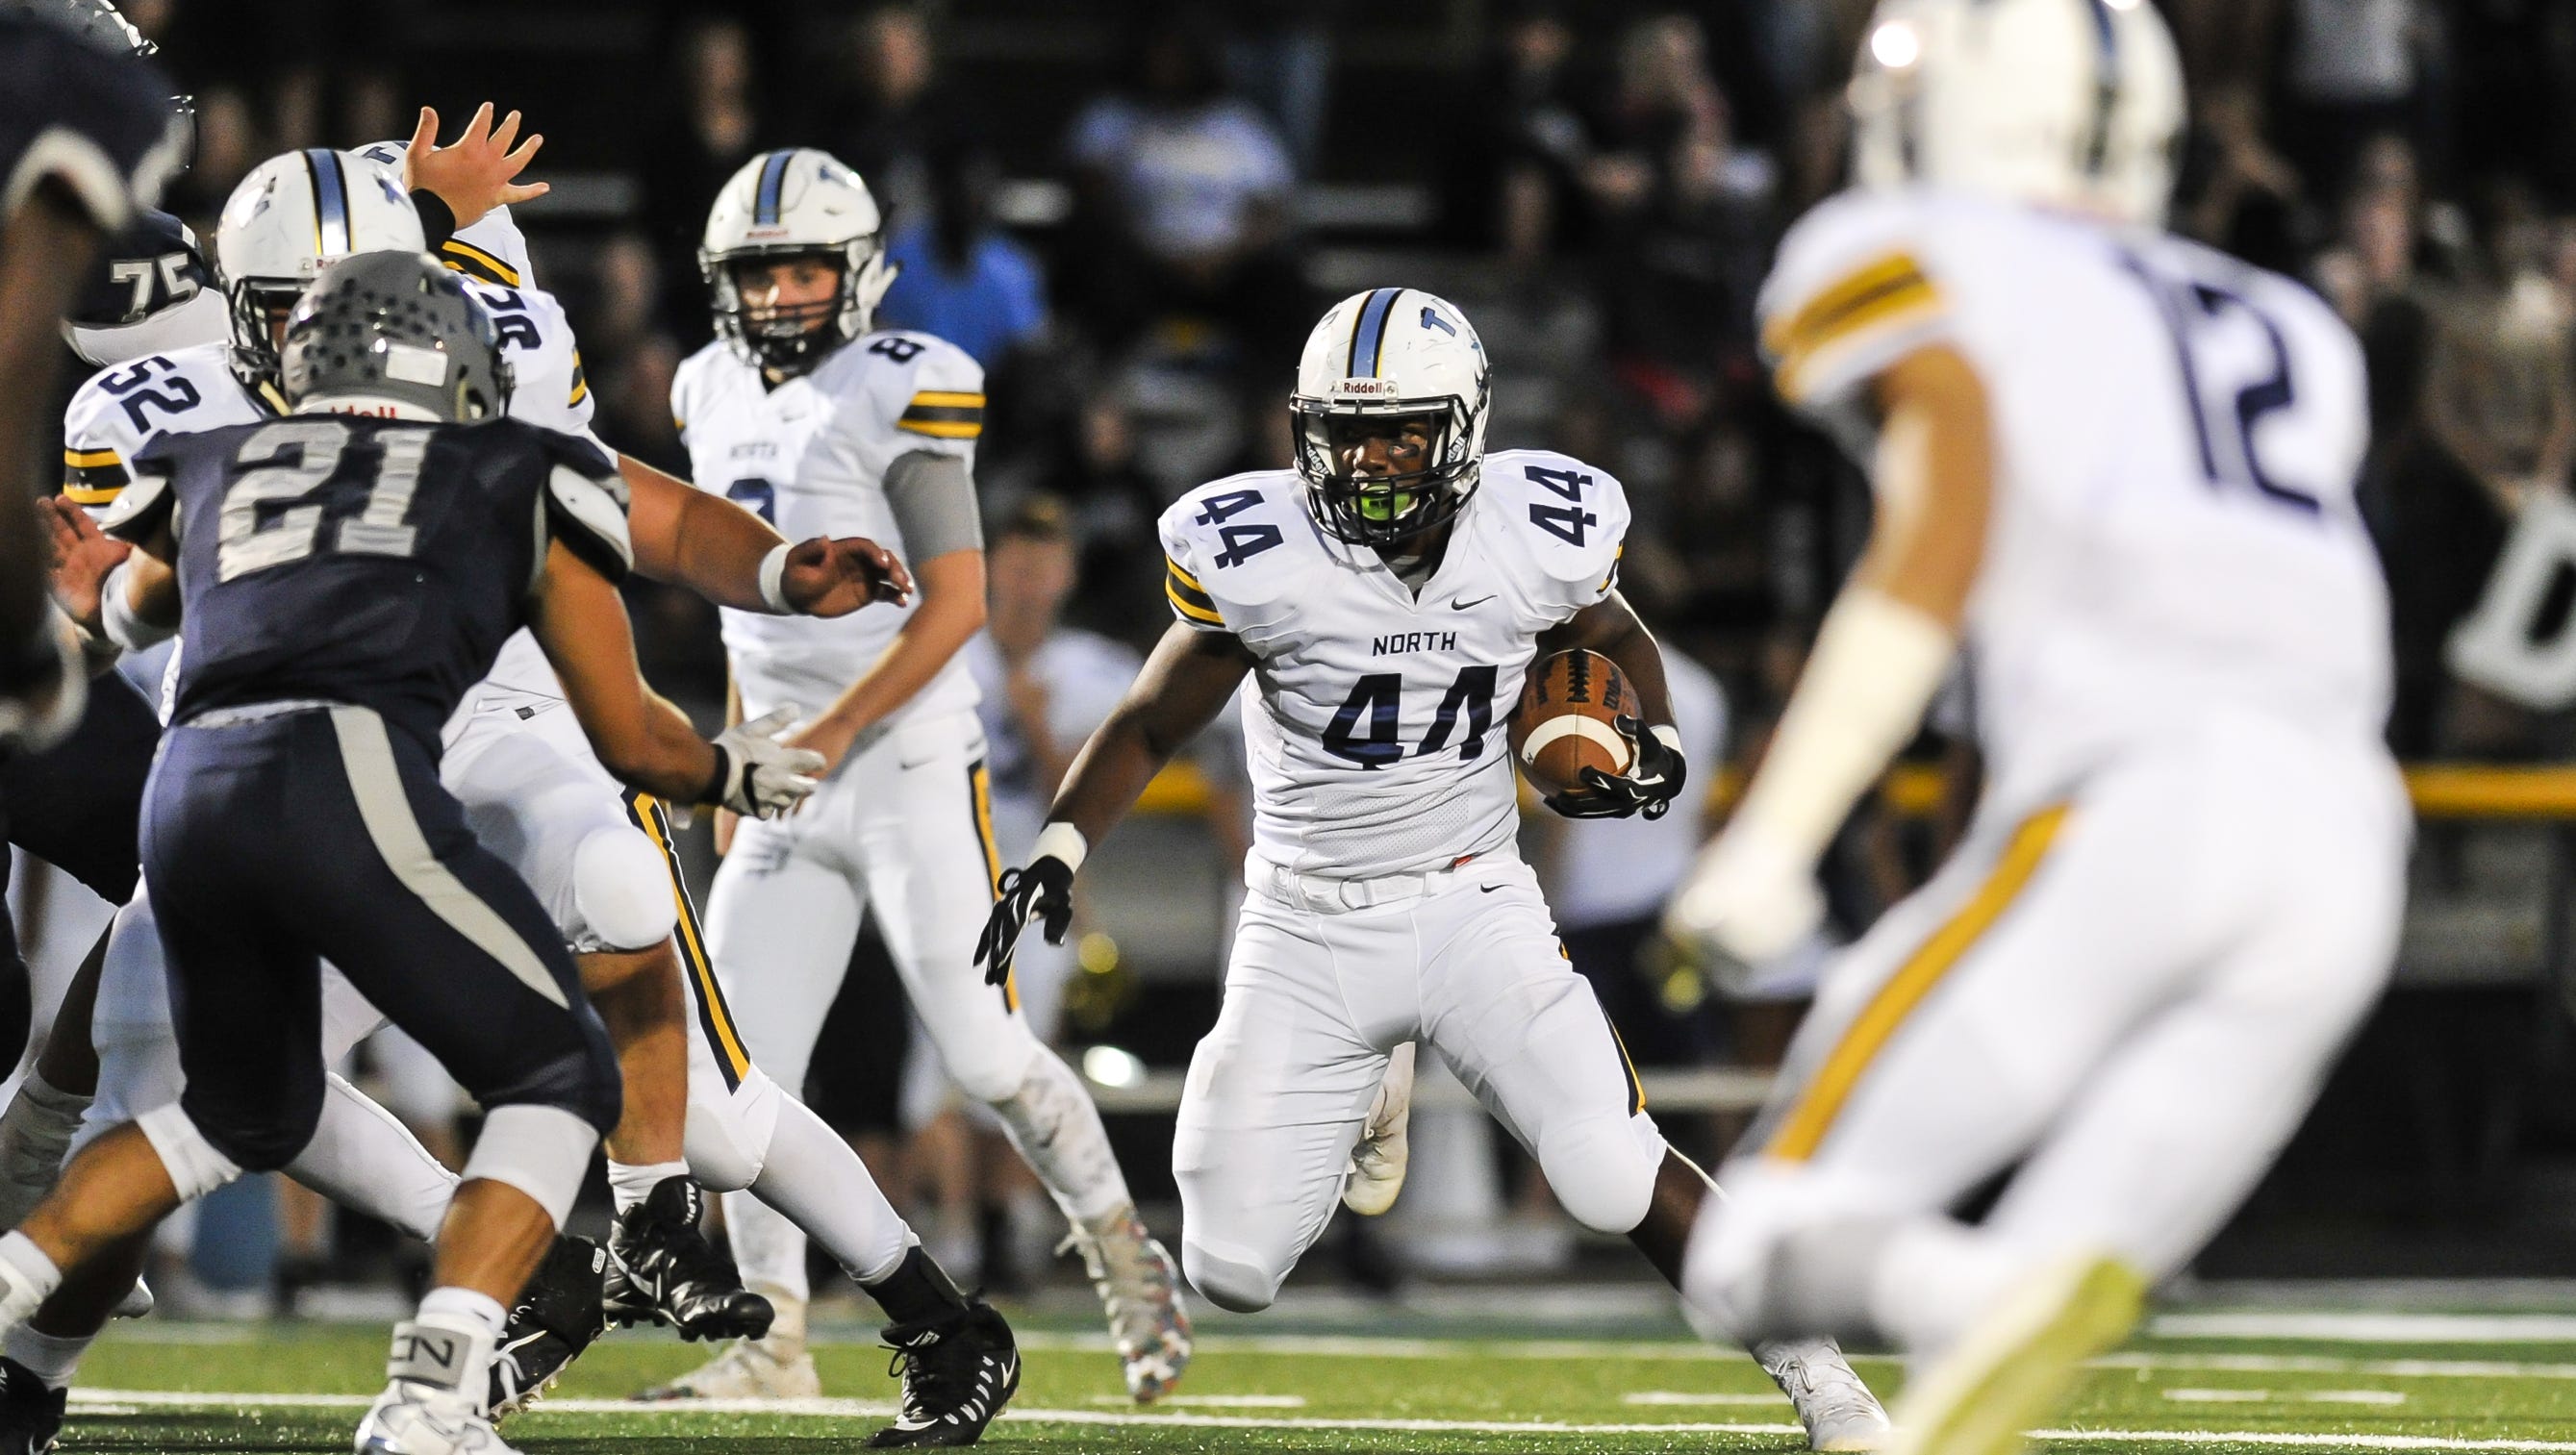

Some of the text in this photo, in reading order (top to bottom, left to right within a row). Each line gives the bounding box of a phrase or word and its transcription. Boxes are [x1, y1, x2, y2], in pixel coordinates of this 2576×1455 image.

[111, 252, 198, 322] 75
[1420, 306, 1456, 338] T
[868, 337, 924, 364] 8
[1343, 381, 1383, 394] Riddell
[2113, 244, 2321, 514] 12
[97, 356, 201, 436] 52
[217, 421, 434, 585] 21
[1194, 488, 1284, 569] 44
[1524, 464, 1598, 548] 44
[1372, 630, 1457, 658] NORTH
[1322, 664, 1500, 771] 44
